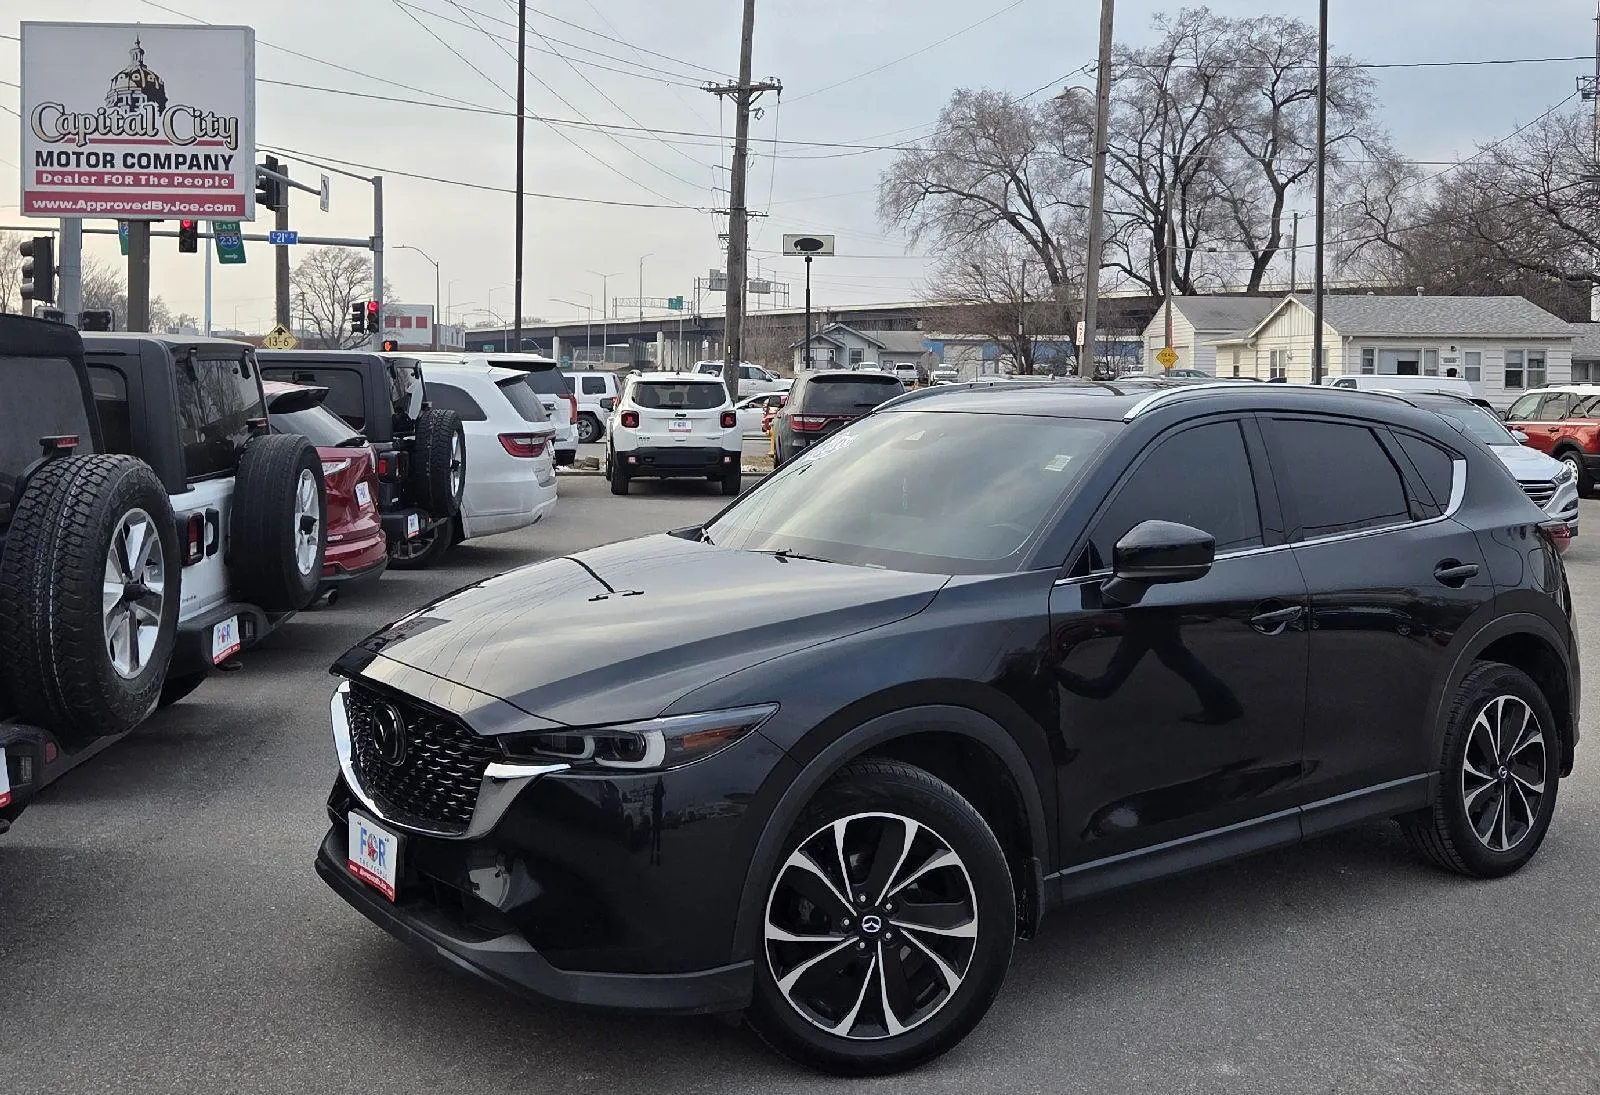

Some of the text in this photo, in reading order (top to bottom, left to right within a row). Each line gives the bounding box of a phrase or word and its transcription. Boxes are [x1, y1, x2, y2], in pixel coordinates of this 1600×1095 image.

[31, 101, 238, 150] Capital City
[35, 150, 234, 171] MOTOR COMPANY
[42, 173, 97, 184] Dealer
[104, 174, 134, 185] FOR
[139, 175, 169, 185] The
[32, 199, 237, 213] www.ApprovedByJoe.com
[215, 222, 236, 230] EAST
[220, 236, 239, 244] 235
